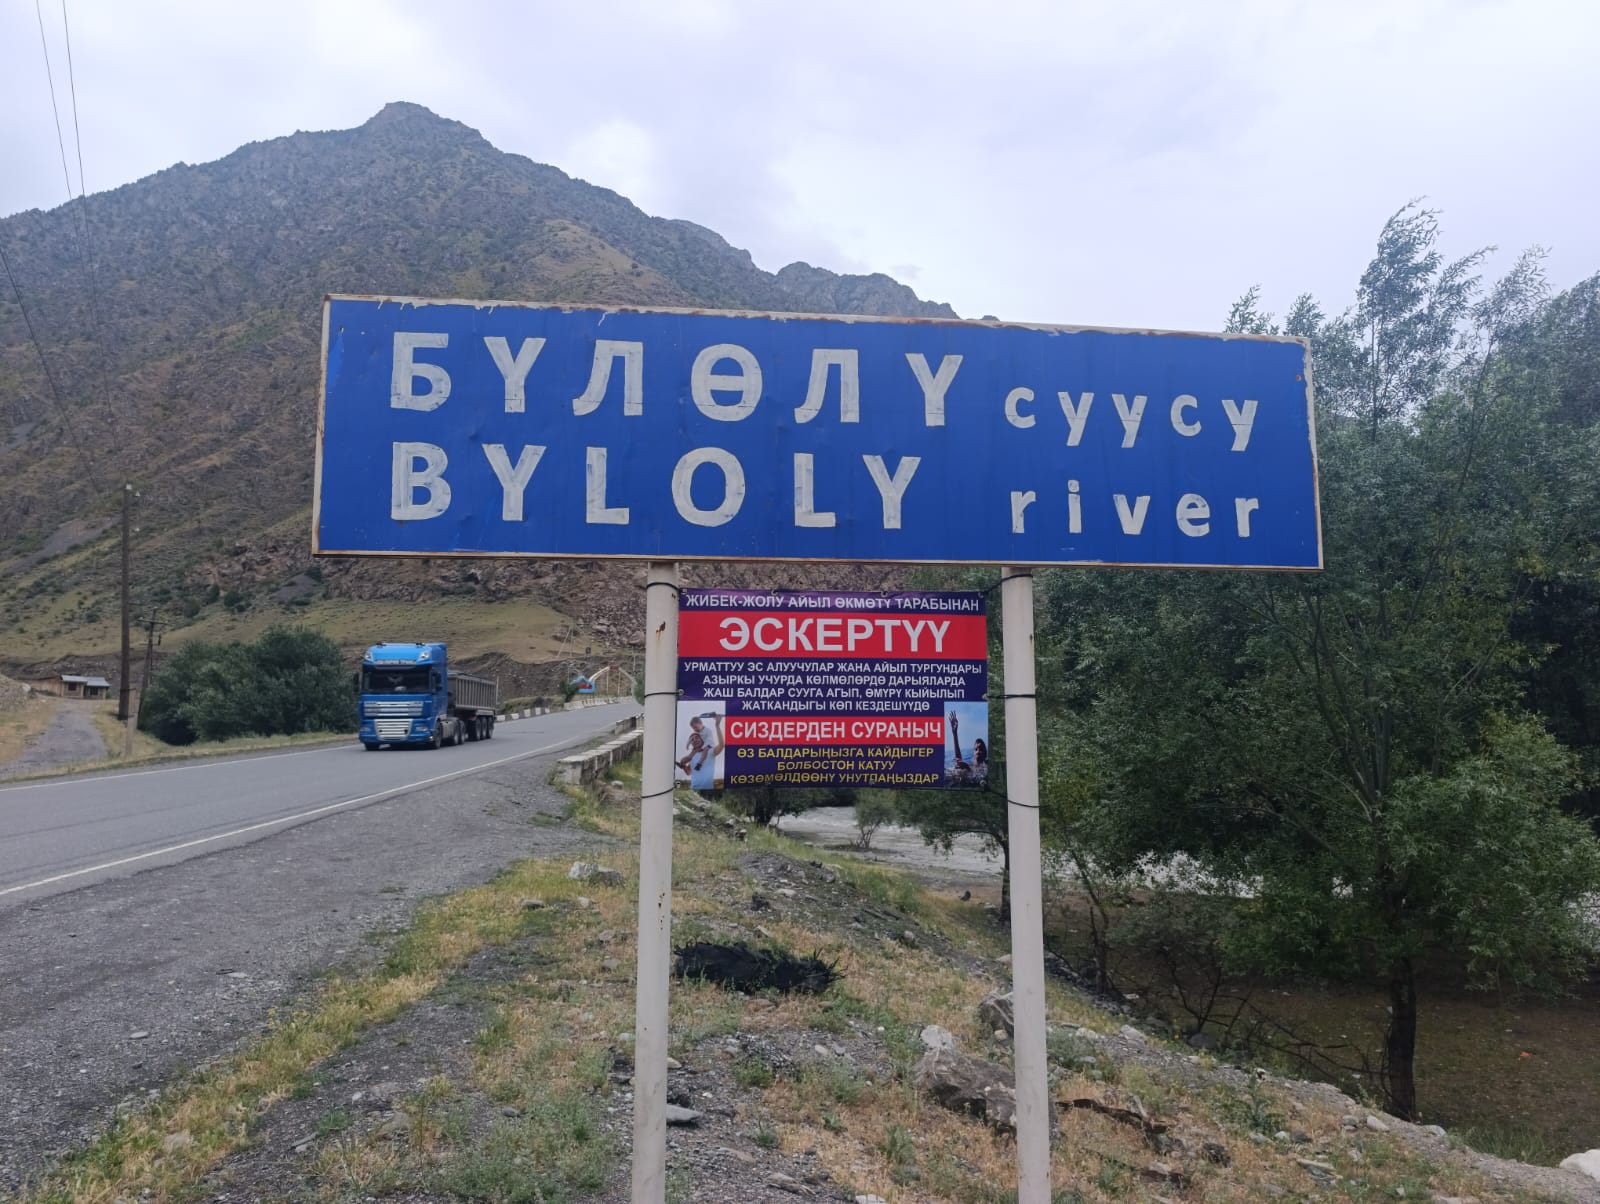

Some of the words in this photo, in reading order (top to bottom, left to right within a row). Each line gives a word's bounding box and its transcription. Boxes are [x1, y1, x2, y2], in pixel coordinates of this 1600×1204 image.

[390, 331, 963, 427] БҮЛӨЛҮ
[1004, 387, 1258, 451] суусу
[391, 441, 921, 529] BYLOLY
[1010, 480, 1259, 537] river
[686, 594, 783, 608] ЖИБЕК-ЖОЛУ
[788, 595, 830, 609] АЙЫЛ
[835, 597, 891, 609] ӨКМӨТҮ
[895, 598, 979, 611] ТАРАБЫНАН
[719, 617, 950, 653] ЭСКЕРТҮҮ
[684, 661, 744, 673] УРМАТТУУ
[747, 662, 763, 673] ЭС
[766, 662, 834, 673] АЛУУЧУЛАР
[837, 662, 871, 673] ЖАНА
[874, 661, 907, 673] АЙЫЛ
[910, 663, 982, 675] ТУРГУНДАРЫ
[703, 675, 755, 685] АЗЫРКЫ
[758, 675, 803, 686] УЧУРДА
[806, 675, 886, 687] КӨЛМӨЛӨРДӨ
[888, 676, 965, 687] ДАРЫЯЛАРДА
[703, 688, 737, 698] ЖАШ
[739, 688, 786, 699] БАЛДАР
[789, 688, 824, 699] СУУГА
[827, 688, 862, 700] АГЫП,
[865, 688, 902, 699] ӨМҮРҮ
[904, 687, 965, 699] КЫЙЫЛЫП
[742, 700, 826, 712] ЖАТКАНДЫГЫ
[829, 700, 853, 711] КӨП
[855, 701, 930, 712] КЕЗДЕШҮҮДӨ
[730, 721, 846, 740] СИЗДЕРДЕН
[851, 721, 942, 738] СУРАНЫЧ
[737, 748, 755, 758] ӨЗ
[758, 748, 864, 759] БАЛДАРЫҢЫЗГА
[867, 746, 934, 759] КАЙДЫГЕР
[777, 760, 855, 771] БОЛБОСТОН
[858, 760, 896, 770] КАТУУ
[730, 772, 835, 785] КӨЗӨМӨЛДӨӨНҮ
[838, 772, 939, 785] УНУТПАҢЫЗДАР
